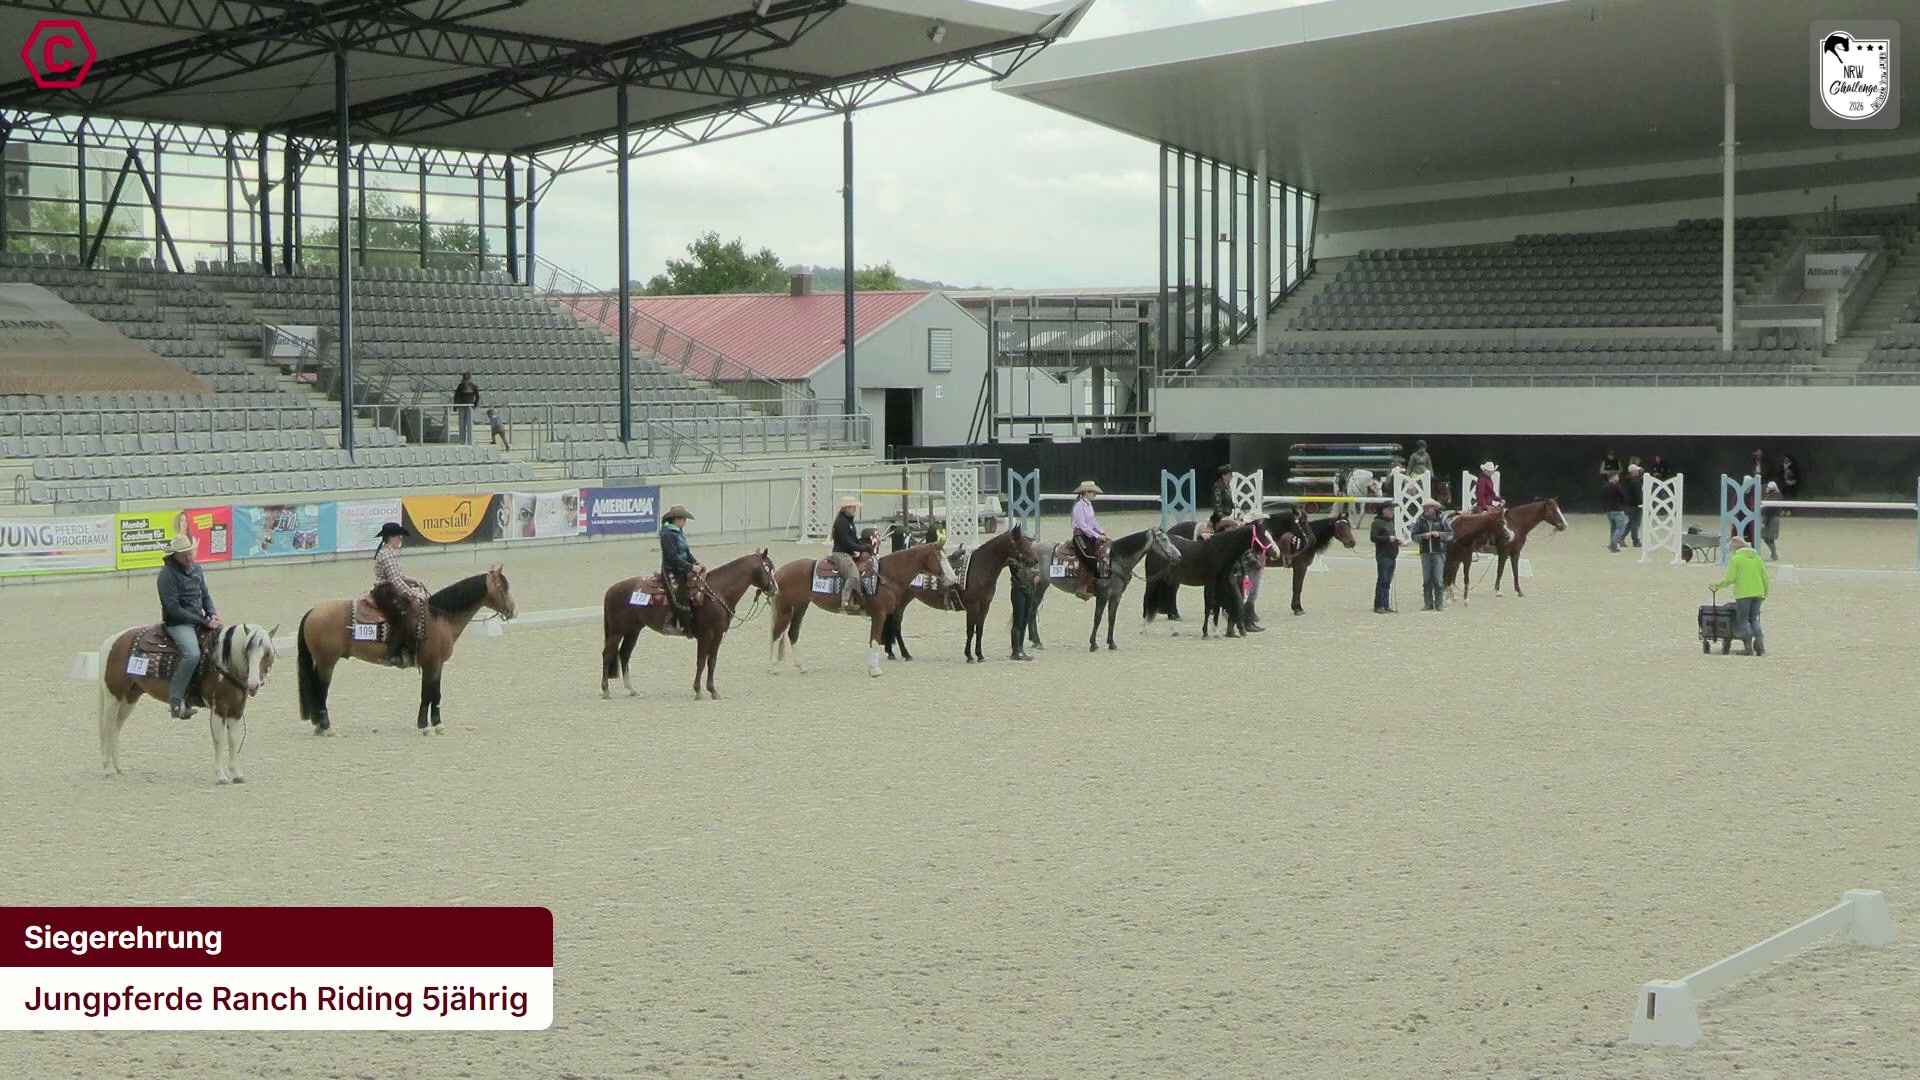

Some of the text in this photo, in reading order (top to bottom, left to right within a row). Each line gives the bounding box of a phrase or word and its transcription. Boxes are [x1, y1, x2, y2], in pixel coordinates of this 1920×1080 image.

[1807, 267, 1838, 277] Allianz
[592, 497, 654, 517] AMERICANA
[121, 518, 149, 530] Mental-
[423, 512, 468, 530] marstall
[55, 523, 91, 535] PFERDE
[0, 524, 54, 548] JUNG
[56, 533, 109, 547] PROGRAMM
[121, 530, 165, 542] Coaching für
[359, 625, 373, 636] 109
